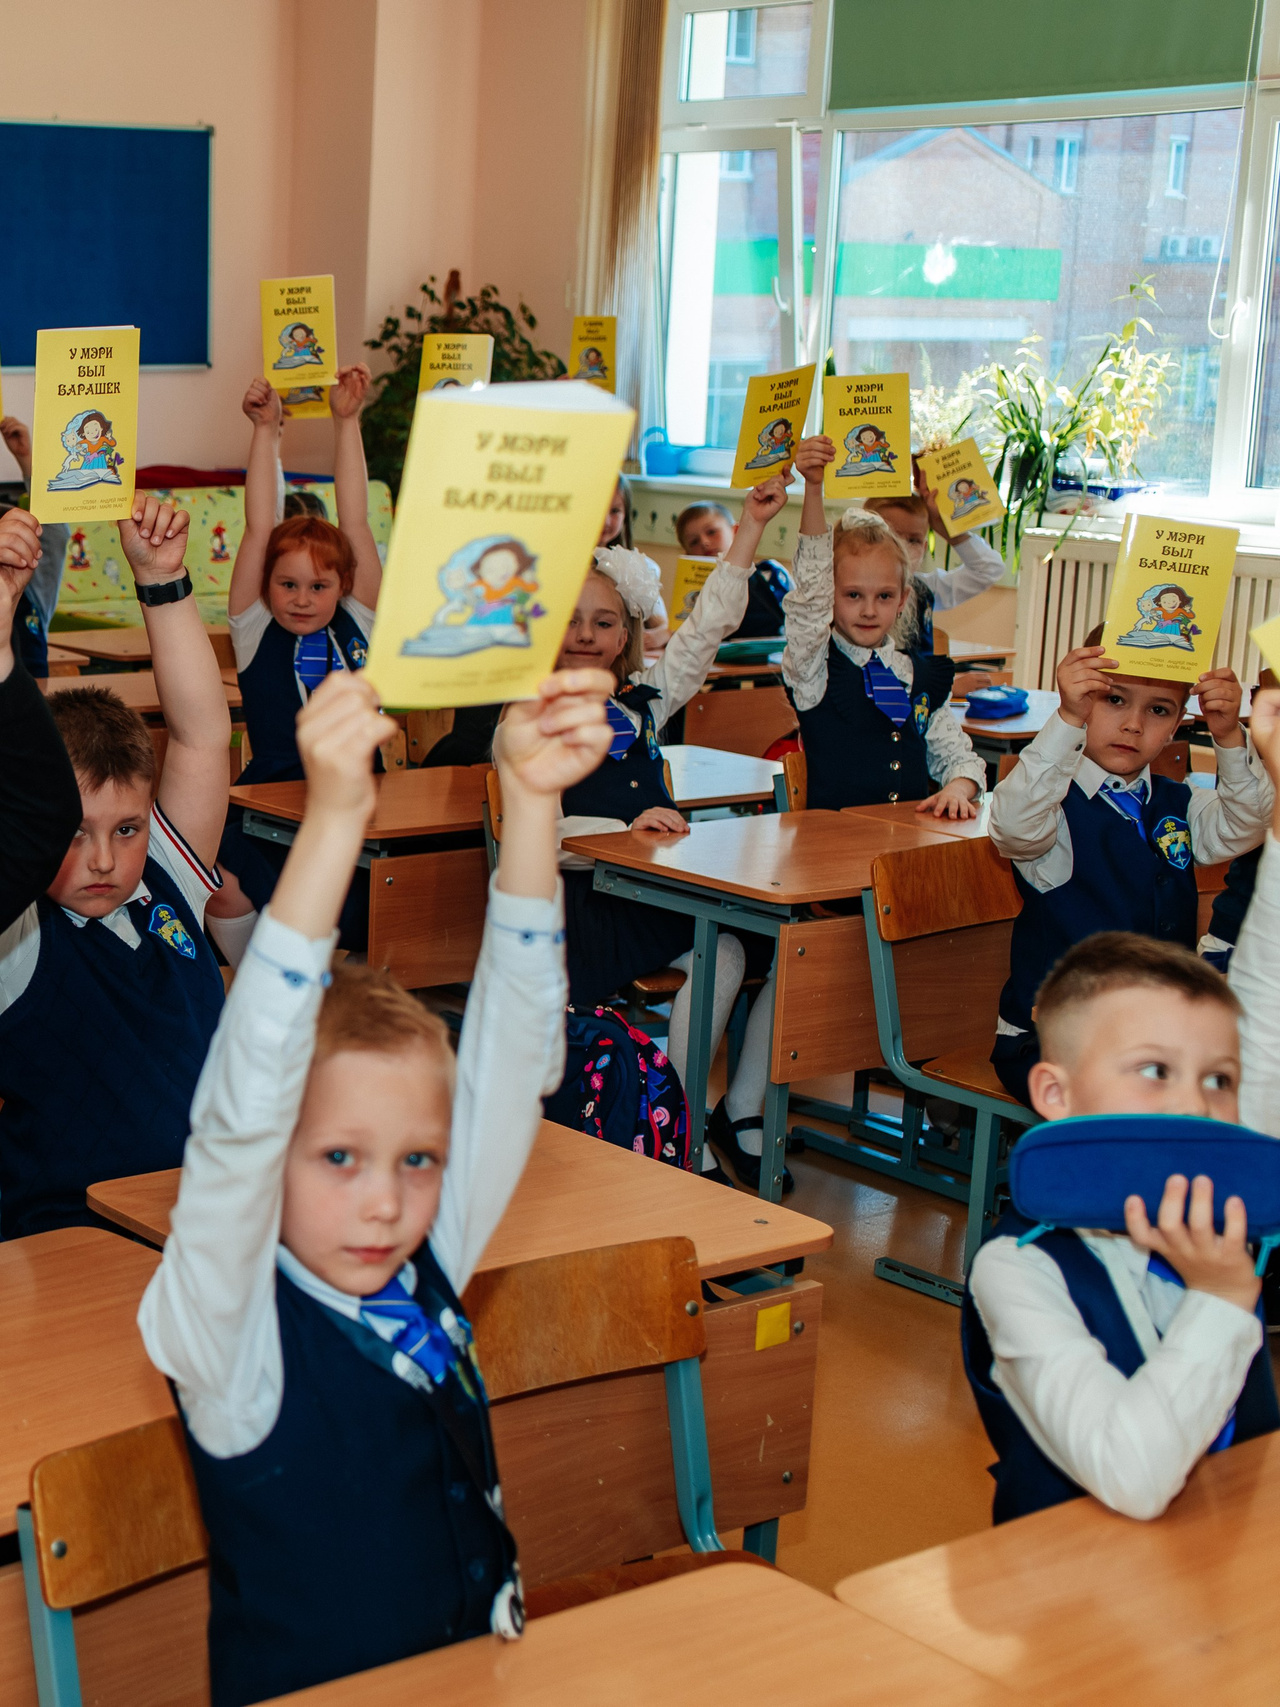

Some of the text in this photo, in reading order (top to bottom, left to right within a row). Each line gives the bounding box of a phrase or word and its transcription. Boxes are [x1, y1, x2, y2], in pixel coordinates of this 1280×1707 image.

[69, 346, 114, 360] У МЭРИ
[77, 365, 106, 378] БЫЛ
[57, 381, 121, 397] БАРАШЕК
[770, 377, 799, 392] У МЭРИ
[846, 383, 884, 393] У МЭРИ
[773, 389, 793, 401] БЫЛ
[853, 394, 878, 404] БЫЛ
[759, 397, 801, 414] БАРАШЕК
[839, 405, 893, 417] БАРАШЕК
[476, 432, 571, 455] У МЭРИ
[487, 462, 548, 484] БЫЛ
[443, 488, 573, 514] БАРАШЕК
[1155, 529, 1206, 546] У МЭРИ
[1161, 545, 1194, 559] БЫЛ
[1138, 557, 1210, 576] БАРАШЕК
